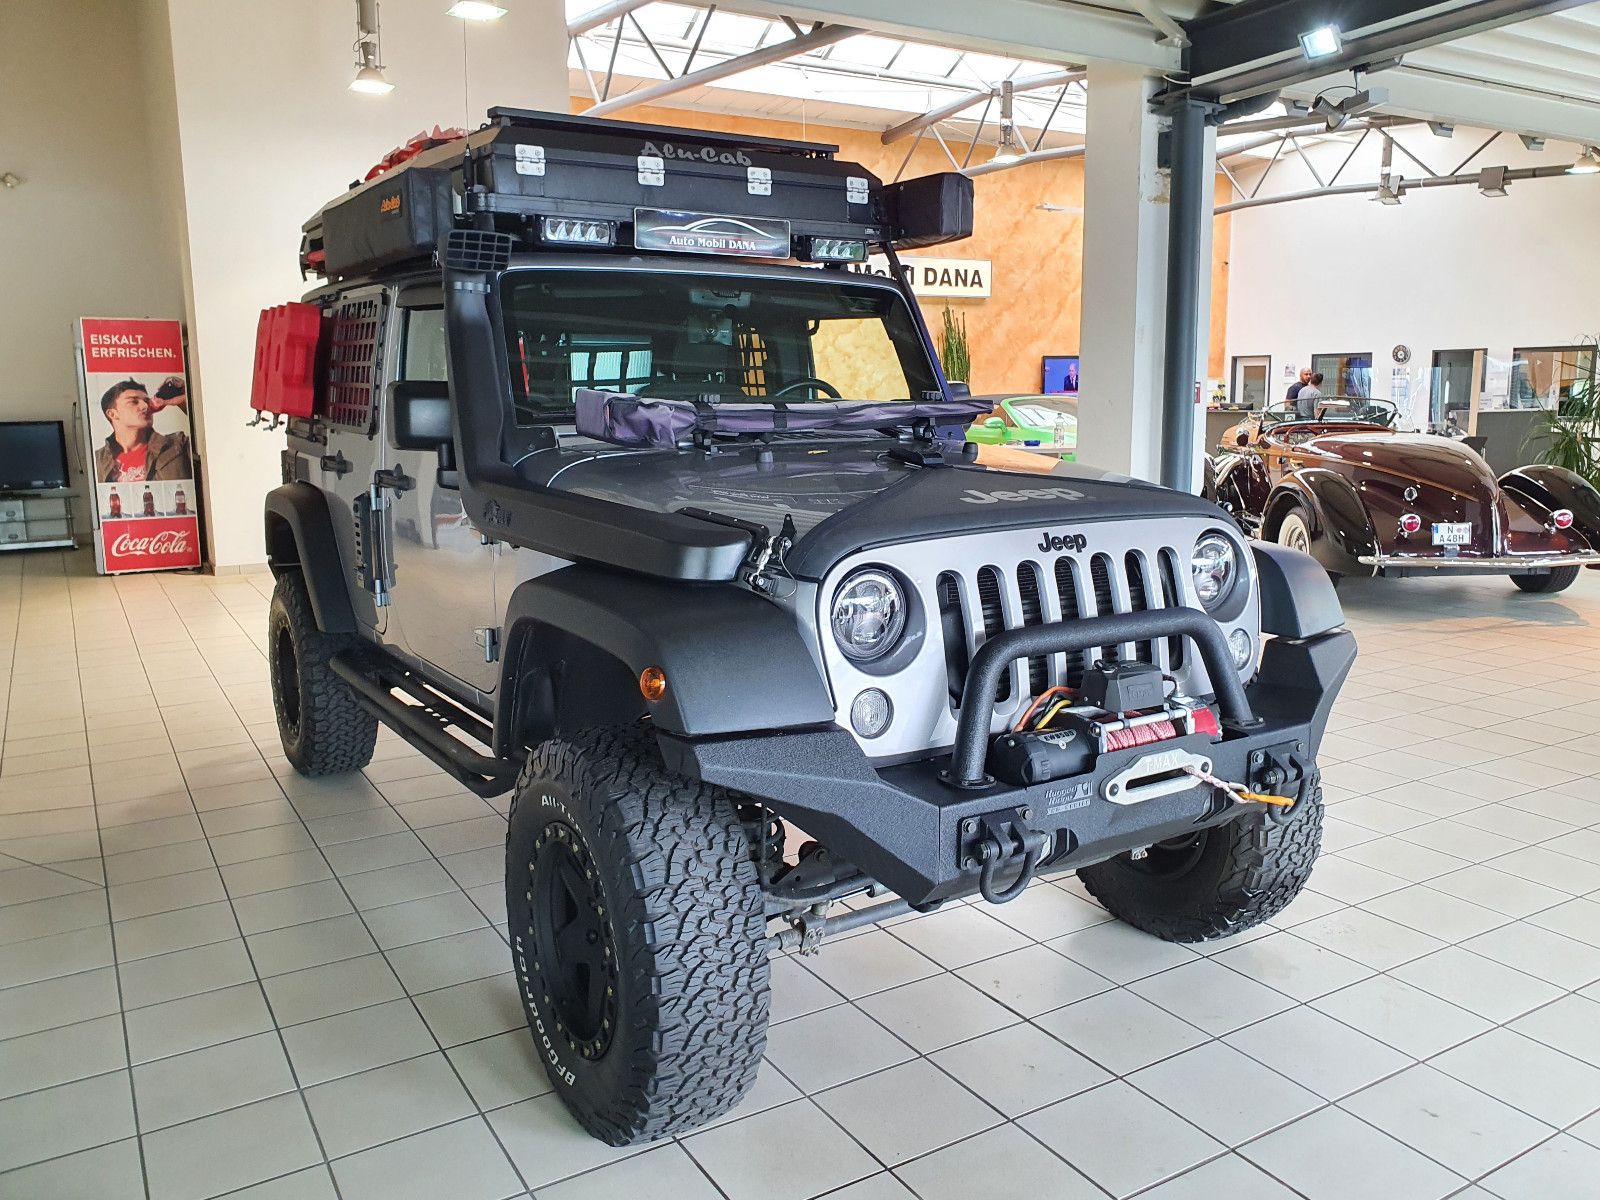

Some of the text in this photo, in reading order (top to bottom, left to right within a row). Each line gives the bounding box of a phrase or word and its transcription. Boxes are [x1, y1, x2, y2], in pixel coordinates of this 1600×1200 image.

[640, 141, 752, 166] Alu-Cab
[669, 235, 756, 251] Auto Mobil DANA
[924, 267, 984, 288] DANA
[90, 334, 144, 345] EISKALT
[91, 347, 177, 359] ERFRISCHEN.
[960, 487, 1085, 504] Jeep
[1037, 532, 1088, 553] Jeep
[516, 935, 576, 1087] BFGoodrich
